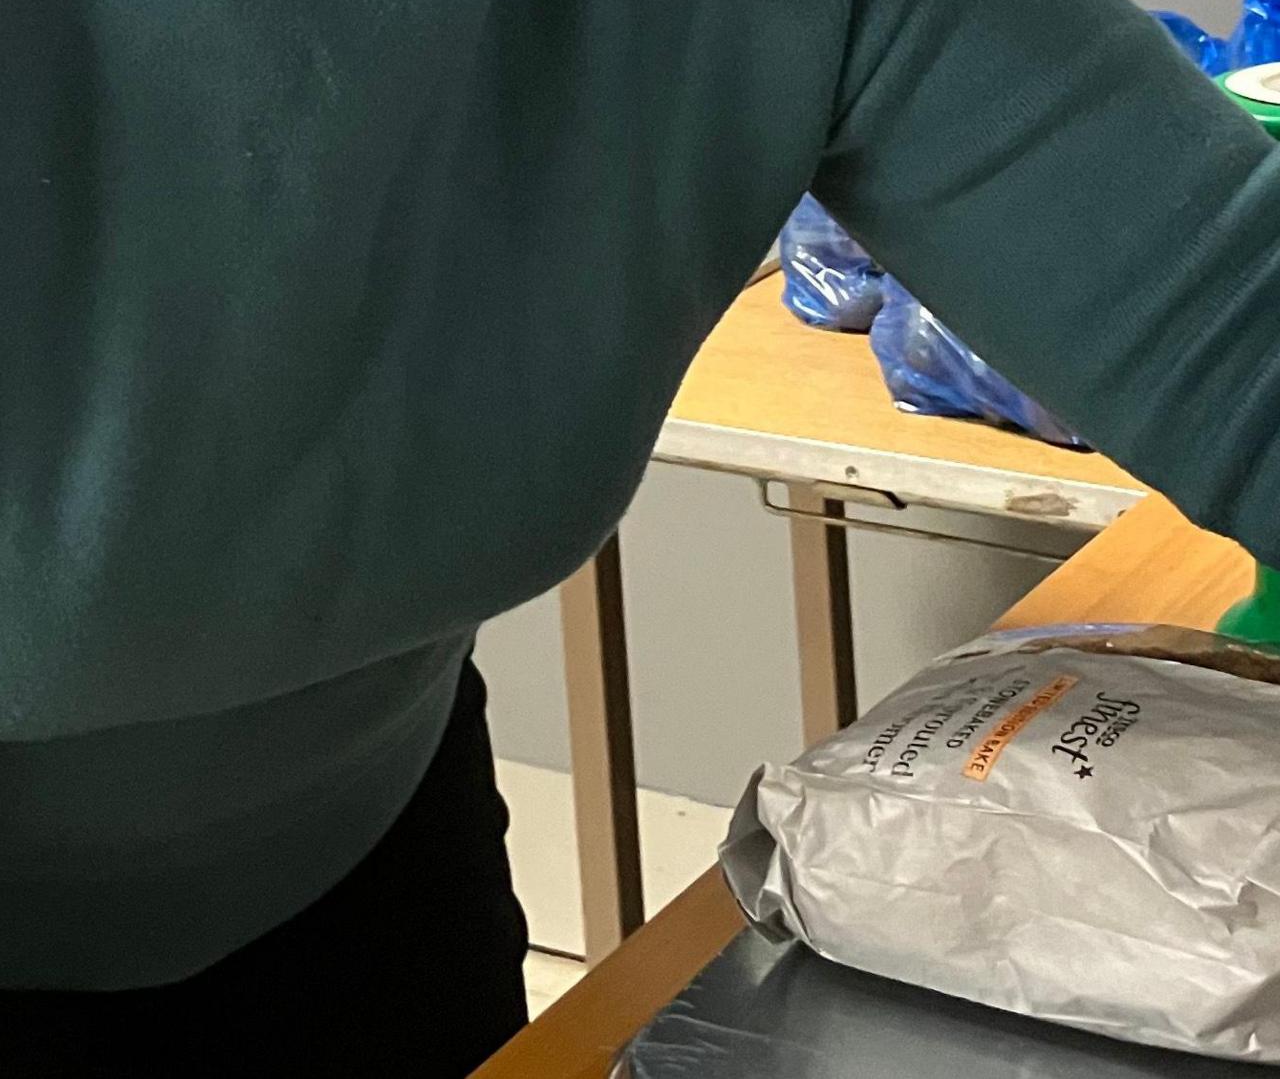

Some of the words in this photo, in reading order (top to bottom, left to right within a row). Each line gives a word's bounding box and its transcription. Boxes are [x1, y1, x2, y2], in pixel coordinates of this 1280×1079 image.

[946, 679, 1031, 749] STONEBAKED
[1051, 691, 1141, 763] finest
[971, 738, 1001, 772] BAKE
